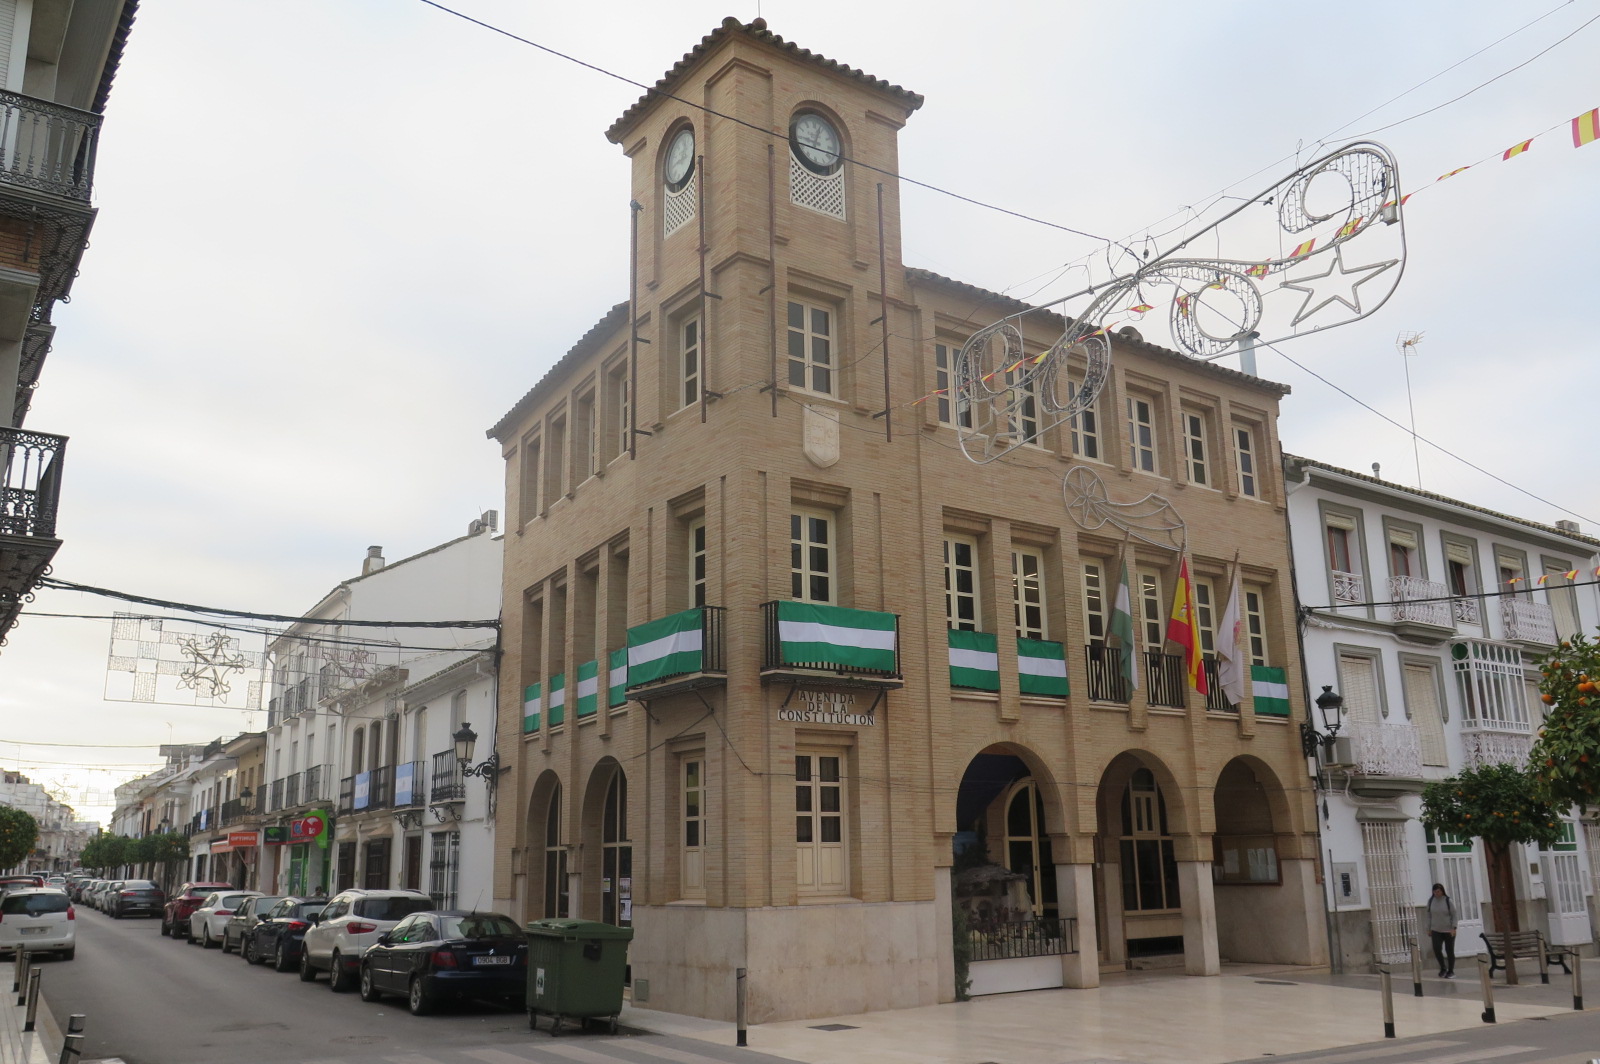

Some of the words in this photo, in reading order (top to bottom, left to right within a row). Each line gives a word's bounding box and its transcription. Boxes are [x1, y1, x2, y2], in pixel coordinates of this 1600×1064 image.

[800, 691, 854, 704] AVENIDA
[808, 702, 822, 712] DE
[832, 703, 847, 713] LA
[779, 711, 874, 725] CONSTITUCION
